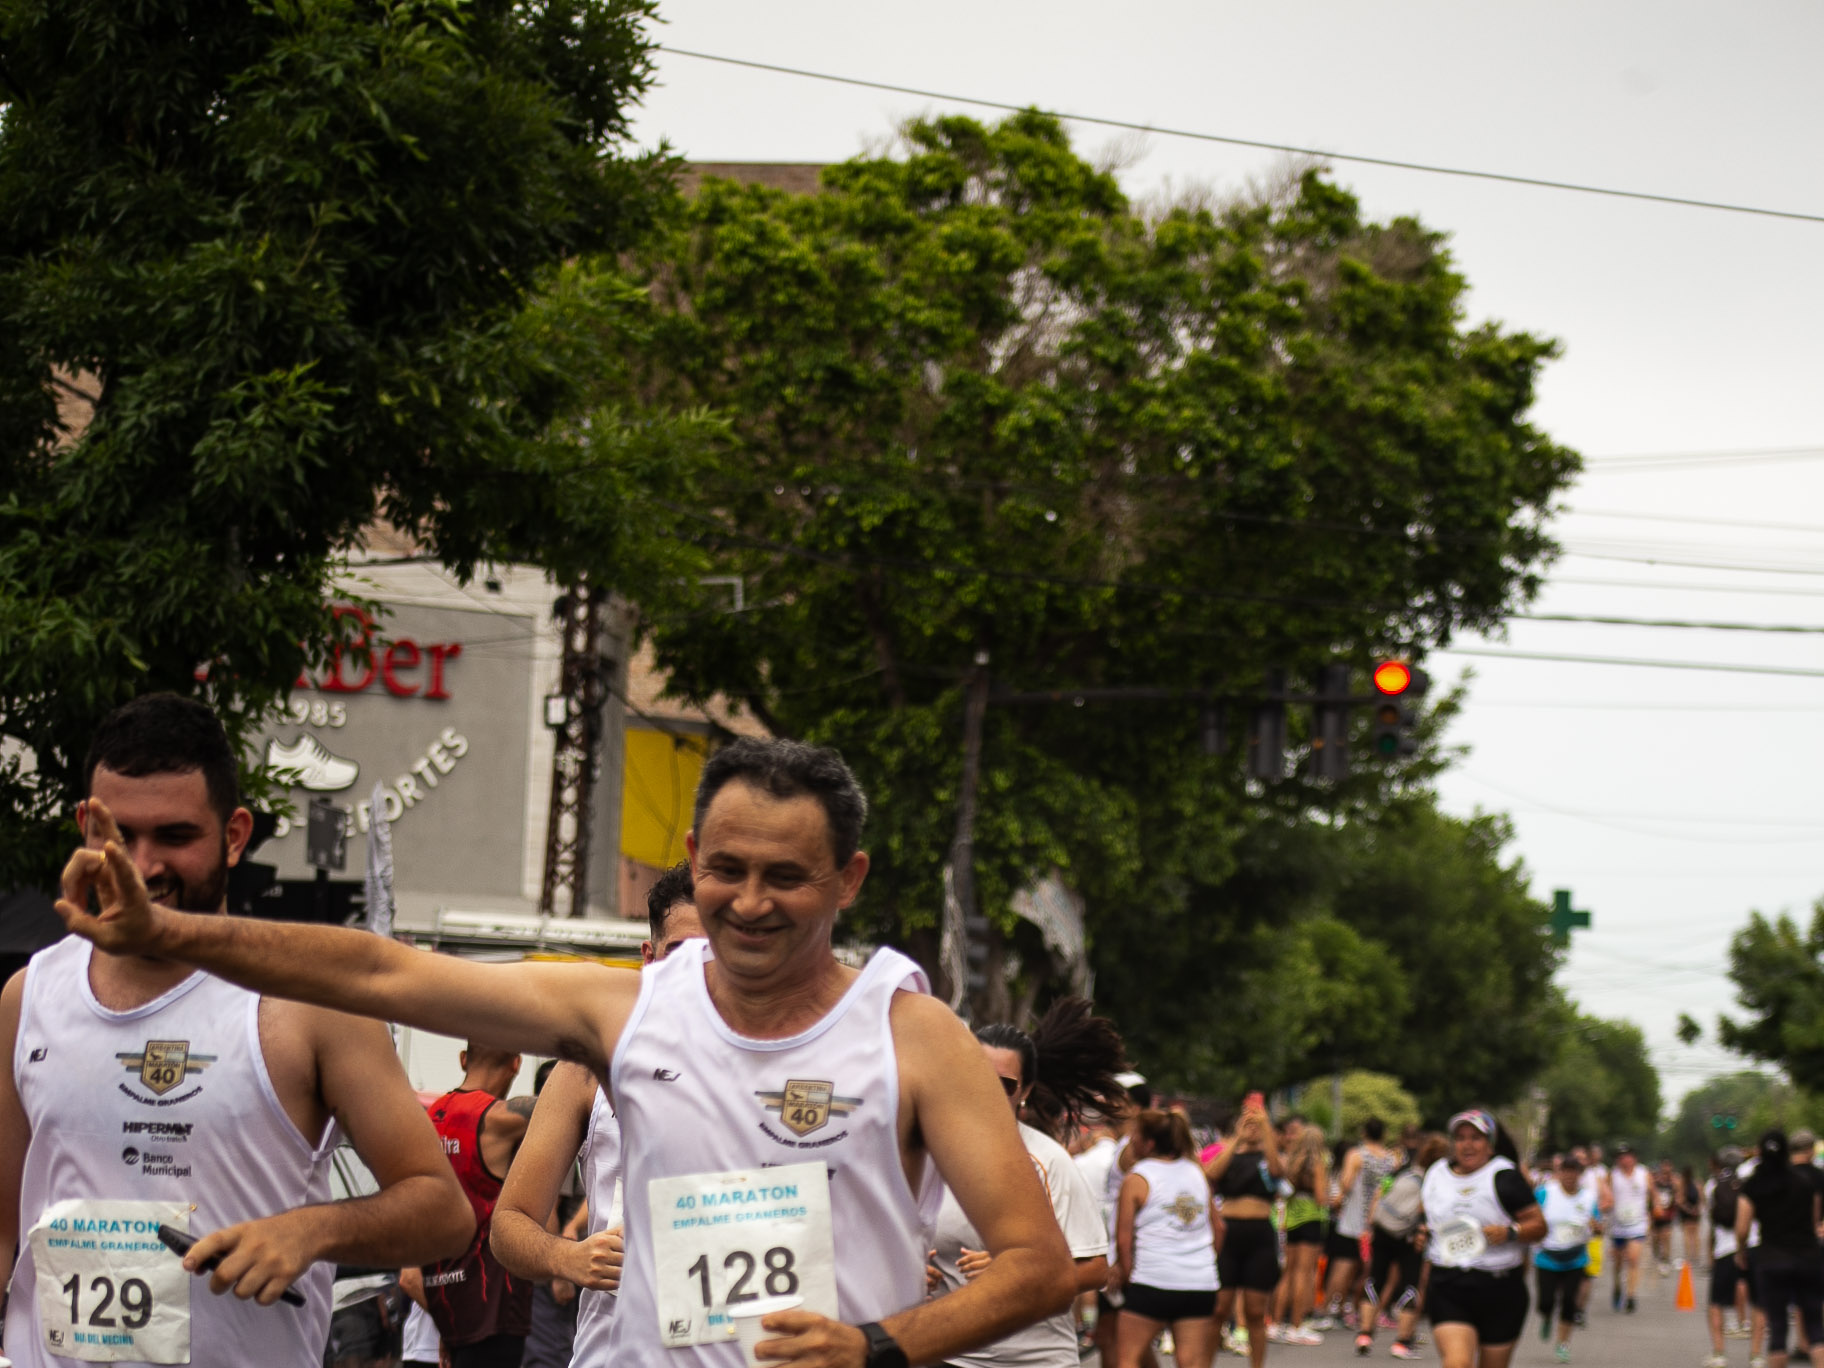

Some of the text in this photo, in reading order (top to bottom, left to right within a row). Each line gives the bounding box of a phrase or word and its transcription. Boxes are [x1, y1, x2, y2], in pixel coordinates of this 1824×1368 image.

[345, 727, 469, 838] PORTES
[150, 1069, 175, 1084] 40
[791, 1109, 818, 1126] 40
[143, 1152, 174, 1164] Banco
[142, 1165, 192, 1178] Municipal
[676, 1184, 799, 1210] 40 MARATON
[50, 1218, 161, 1234] 40 MARATON
[673, 1207, 808, 1230] EMPALME GRANEROS
[48, 1238, 97, 1250] EMPALME
[688, 1246, 800, 1308] 128
[63, 1273, 154, 1330] 129
